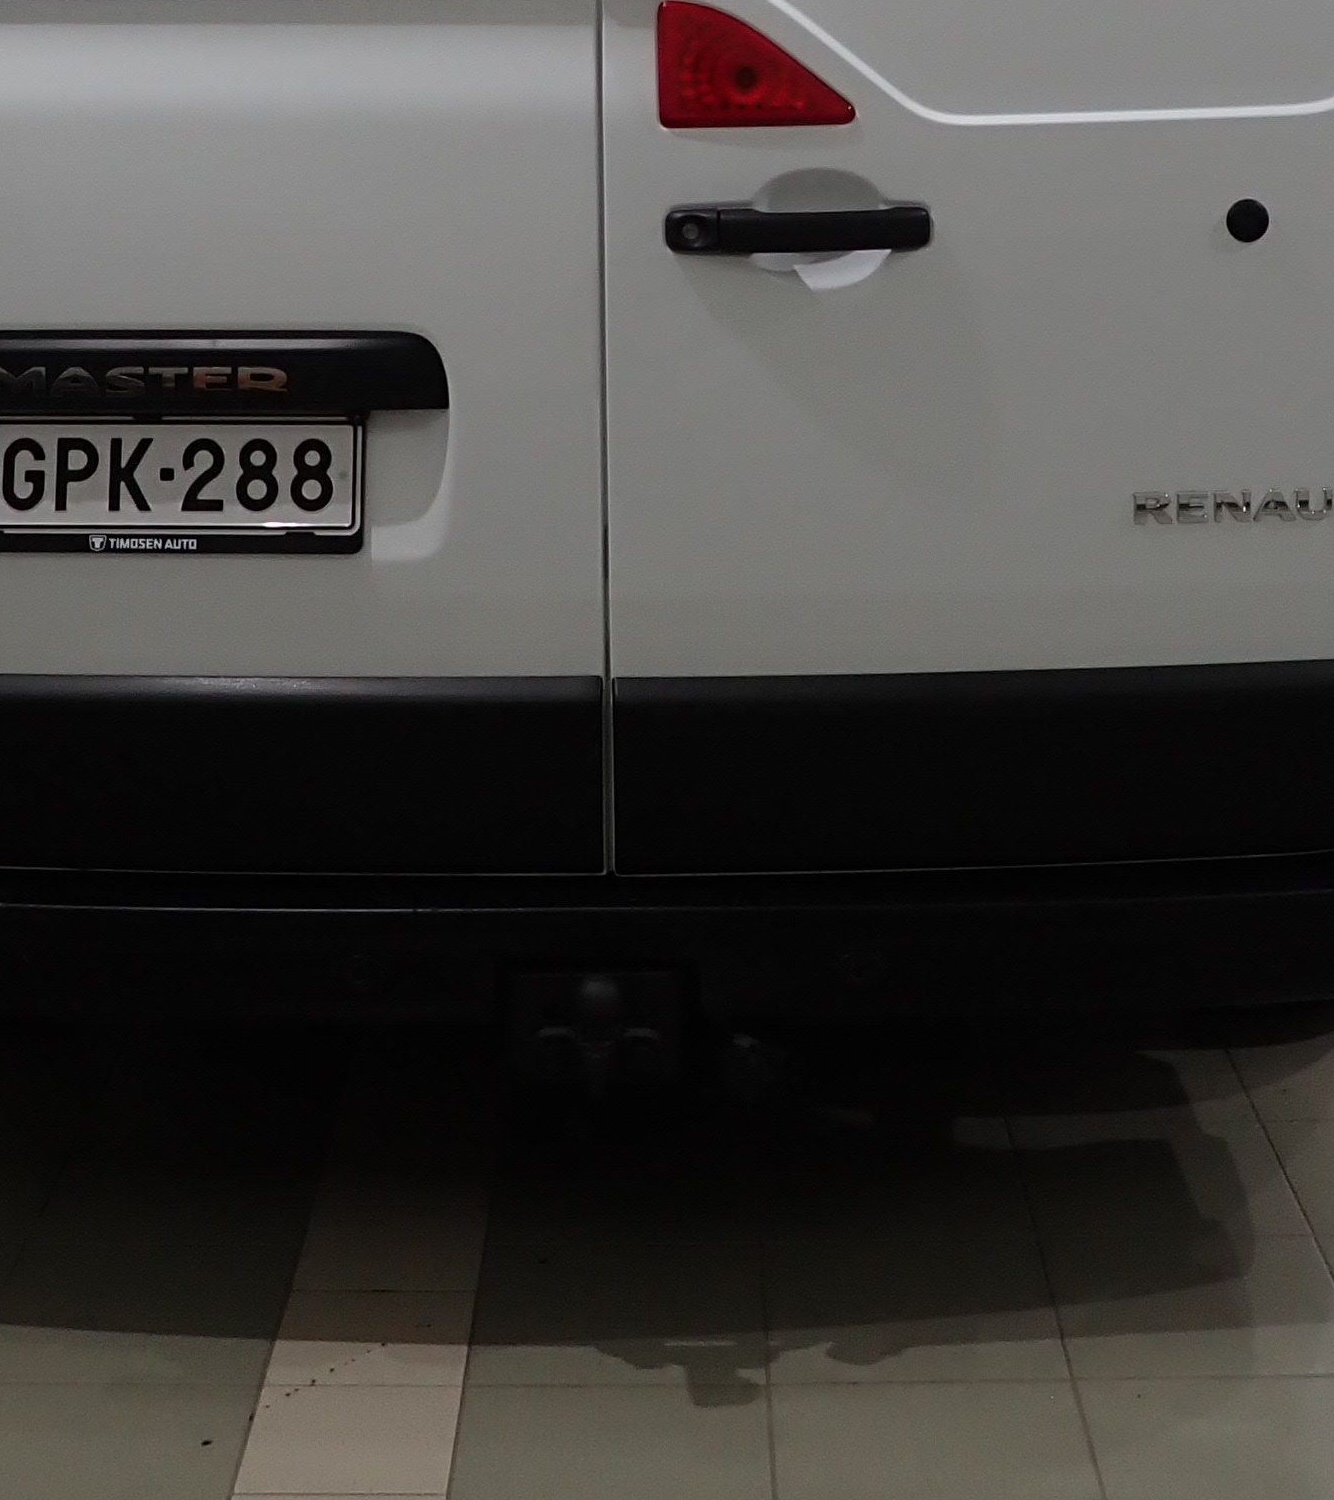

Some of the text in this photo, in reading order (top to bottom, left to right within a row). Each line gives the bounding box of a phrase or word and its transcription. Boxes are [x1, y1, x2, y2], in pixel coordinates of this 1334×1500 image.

[1, 436, 335, 512] GPK-288
[108, 537, 163, 550] TIMOSEN
[163, 538, 198, 550] AUTO
